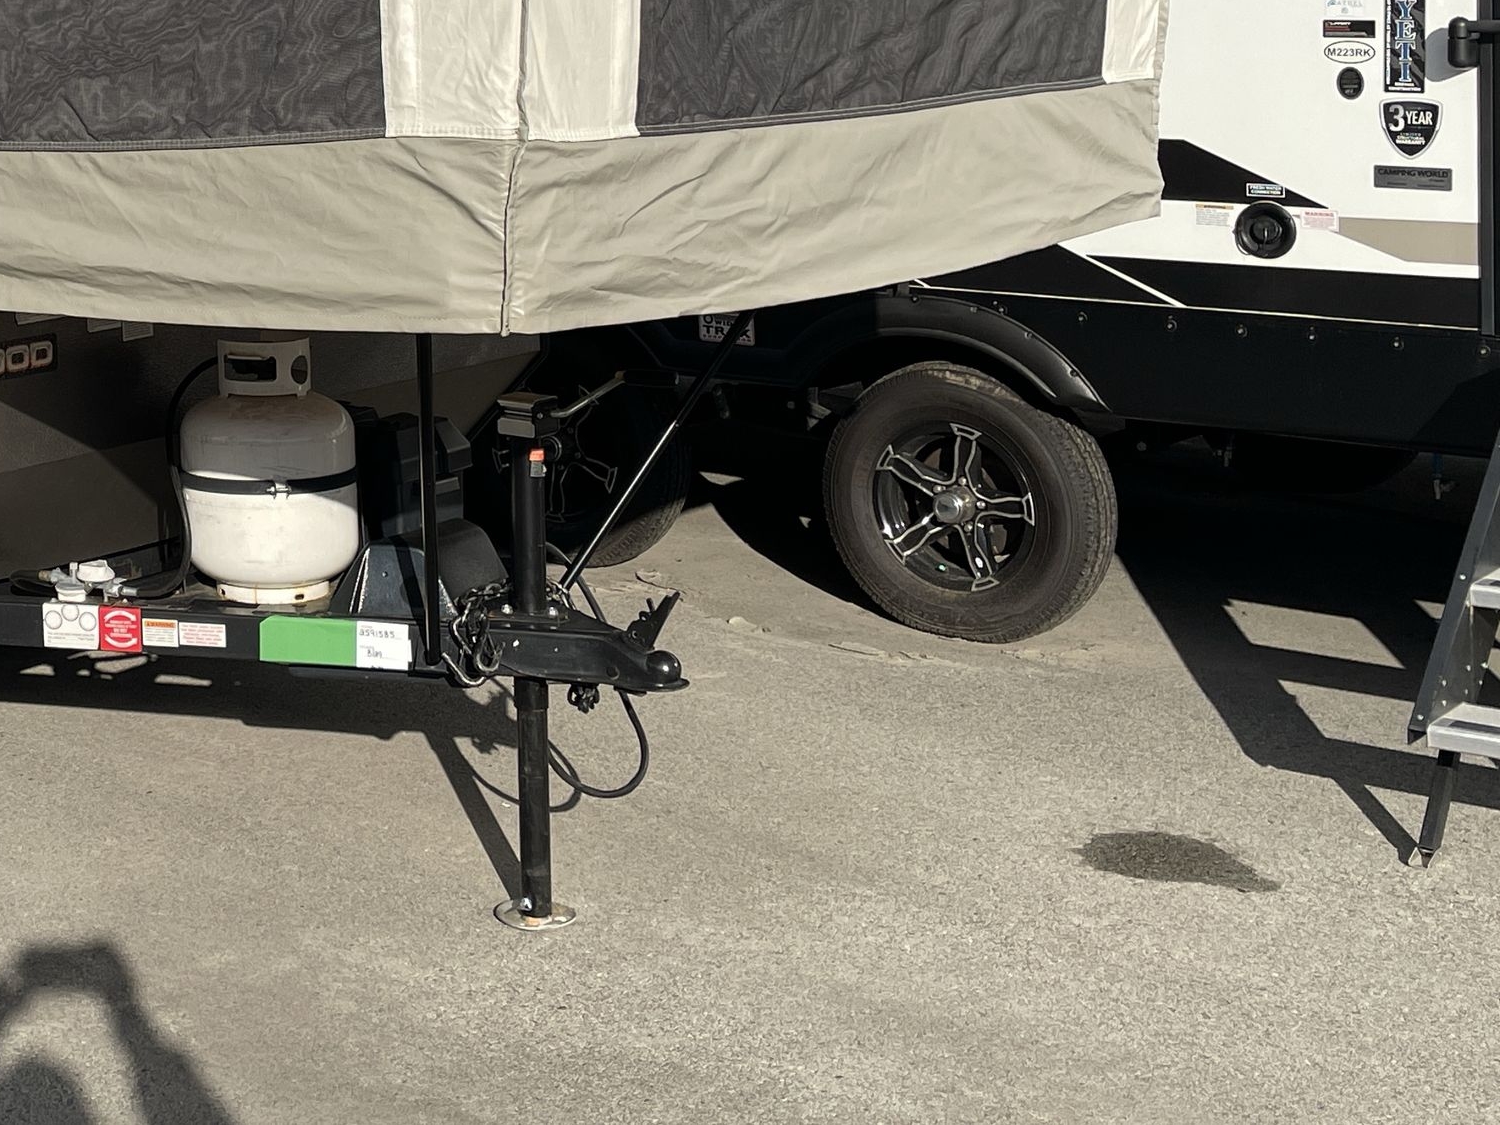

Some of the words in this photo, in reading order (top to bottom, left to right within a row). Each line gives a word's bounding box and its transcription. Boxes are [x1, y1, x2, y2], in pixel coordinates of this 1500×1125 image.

[1394, 0, 1417, 82] YETI
[1327, 47, 1371, 57] M223RK
[1388, 104, 1405, 132] 3
[1405, 110, 1433, 126] YEAR
[1378, 168, 1417, 177] CAMPING
[1417, 170, 1449, 179] WORLD
